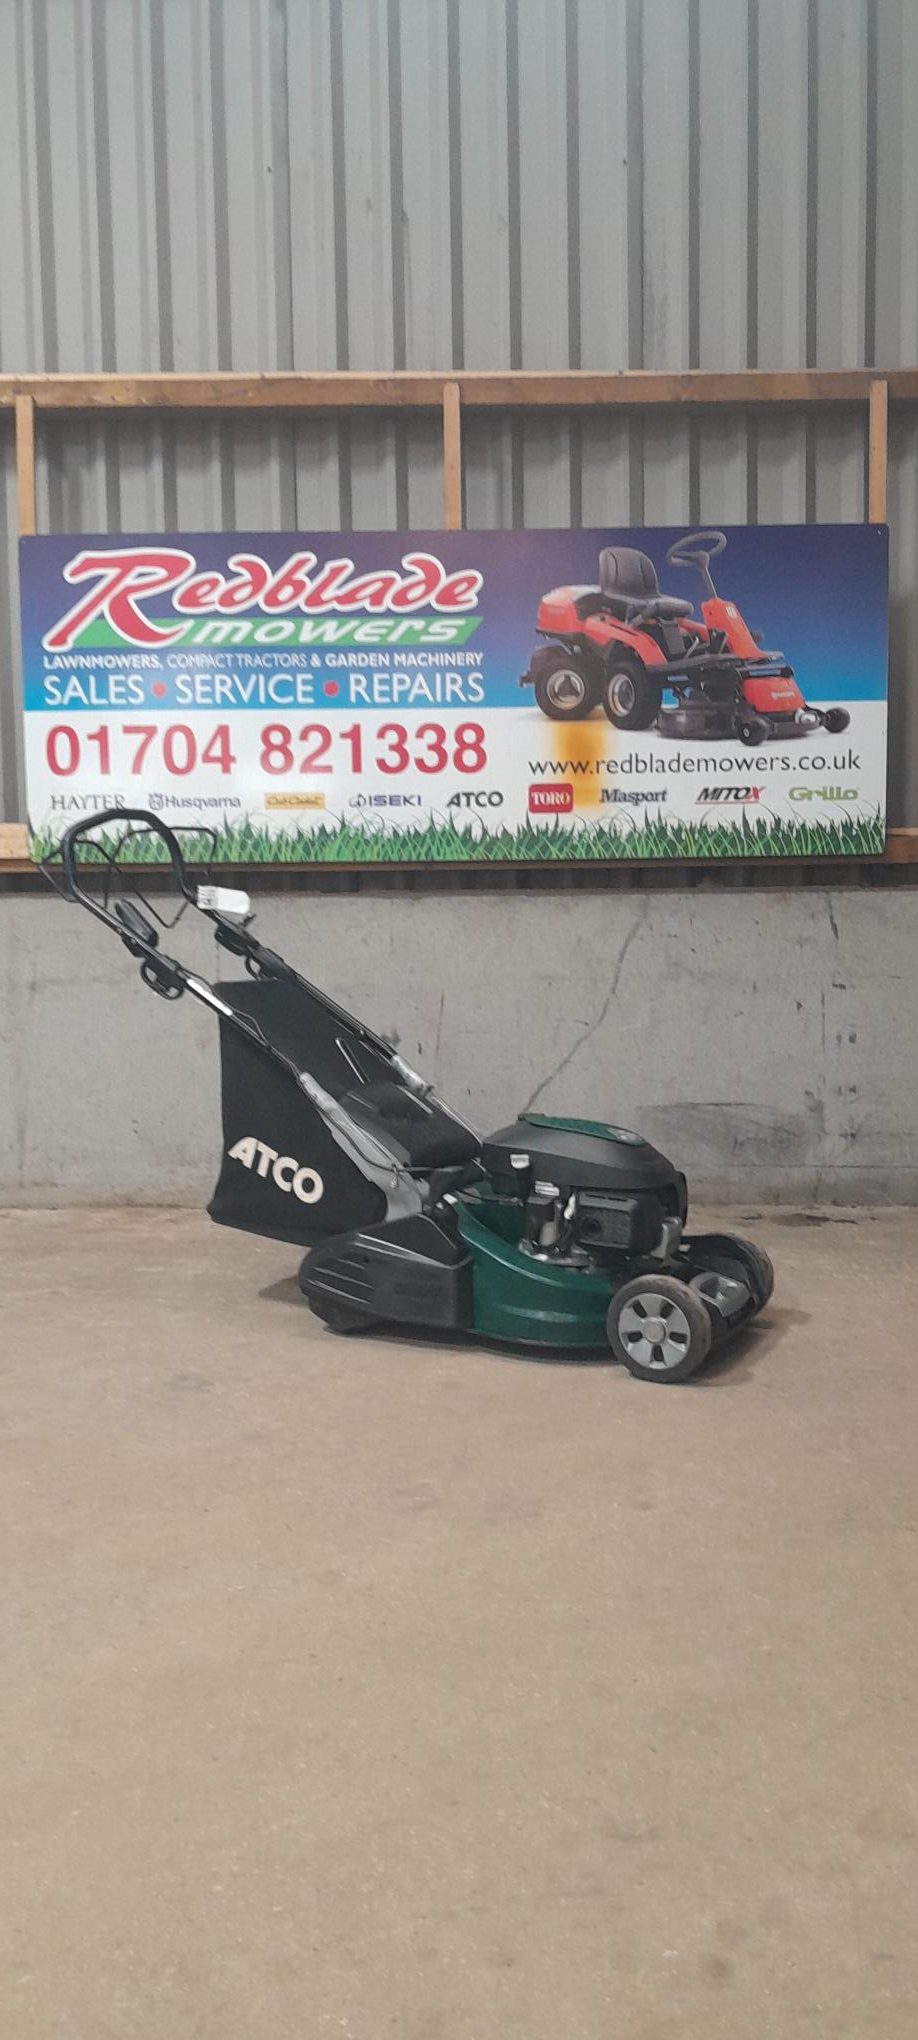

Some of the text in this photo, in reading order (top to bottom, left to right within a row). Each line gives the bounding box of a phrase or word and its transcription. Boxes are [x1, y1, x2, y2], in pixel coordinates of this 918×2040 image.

[42, 547, 484, 652] Redblade
[190, 618, 463, 645] mowers
[43, 651, 484, 670] LAWNMOWERS, COMPACT TRACTORS & GARDEN MACHINERY
[43, 671, 485, 705] SALES SERVICE REPAIRS
[47, 722, 487, 776] 01704 821338
[528, 750, 861, 775] www.redblademowers.co.uk
[50, 794, 126, 810] HAYTER
[165, 794, 241, 811] Husqvarna
[370, 794, 422, 807] ISEKI
[446, 791, 504, 808] ATCO
[531, 791, 571, 806] TORO
[599, 788, 667, 805] Masport
[696, 786, 766, 802] MITOX
[789, 786, 859, 802] Grillo
[228, 1137, 324, 1204] ATCO
